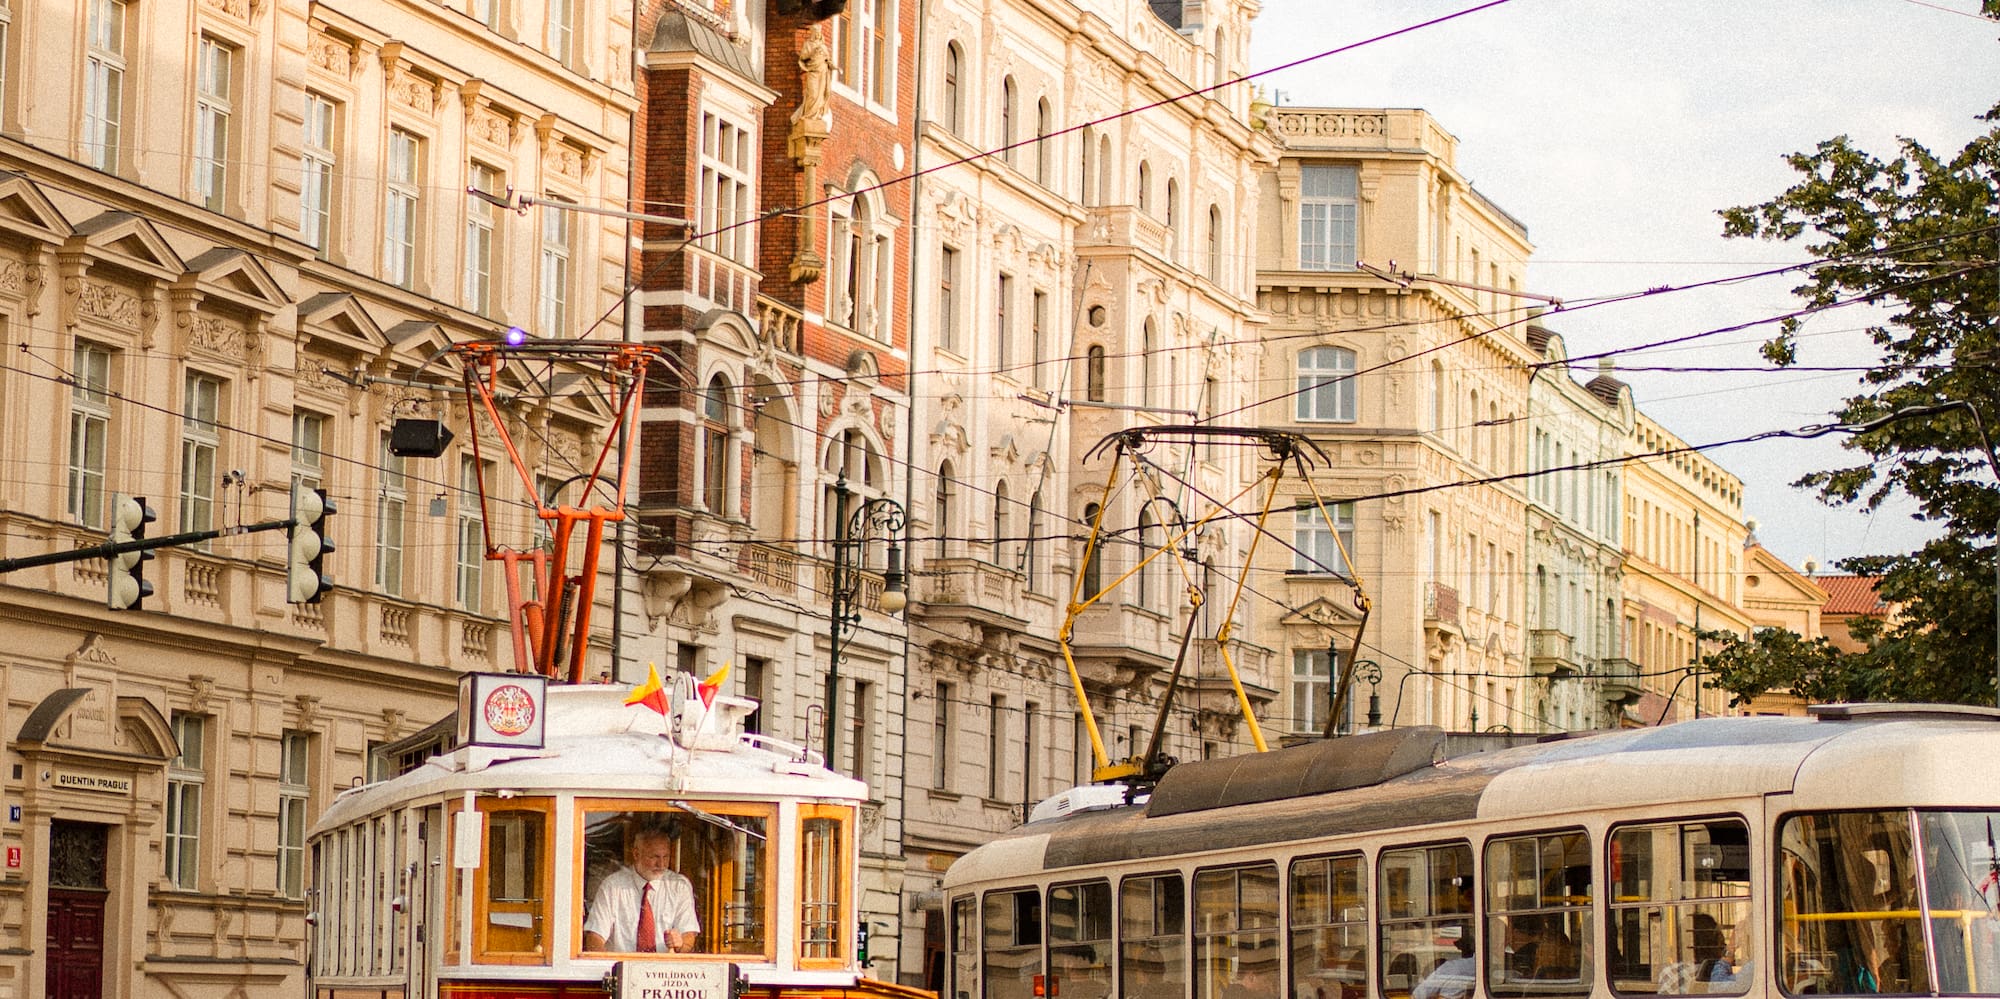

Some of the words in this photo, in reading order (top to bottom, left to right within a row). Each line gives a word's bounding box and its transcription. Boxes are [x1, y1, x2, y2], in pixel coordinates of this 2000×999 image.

[60, 775, 95, 787] QUENTIN
[97, 778, 129, 790] PRAGUE
[645, 970, 706, 980] VYHLÍDKOVÁ
[661, 979, 690, 988] JÍZDA
[642, 988, 708, 999] PRAHOU
